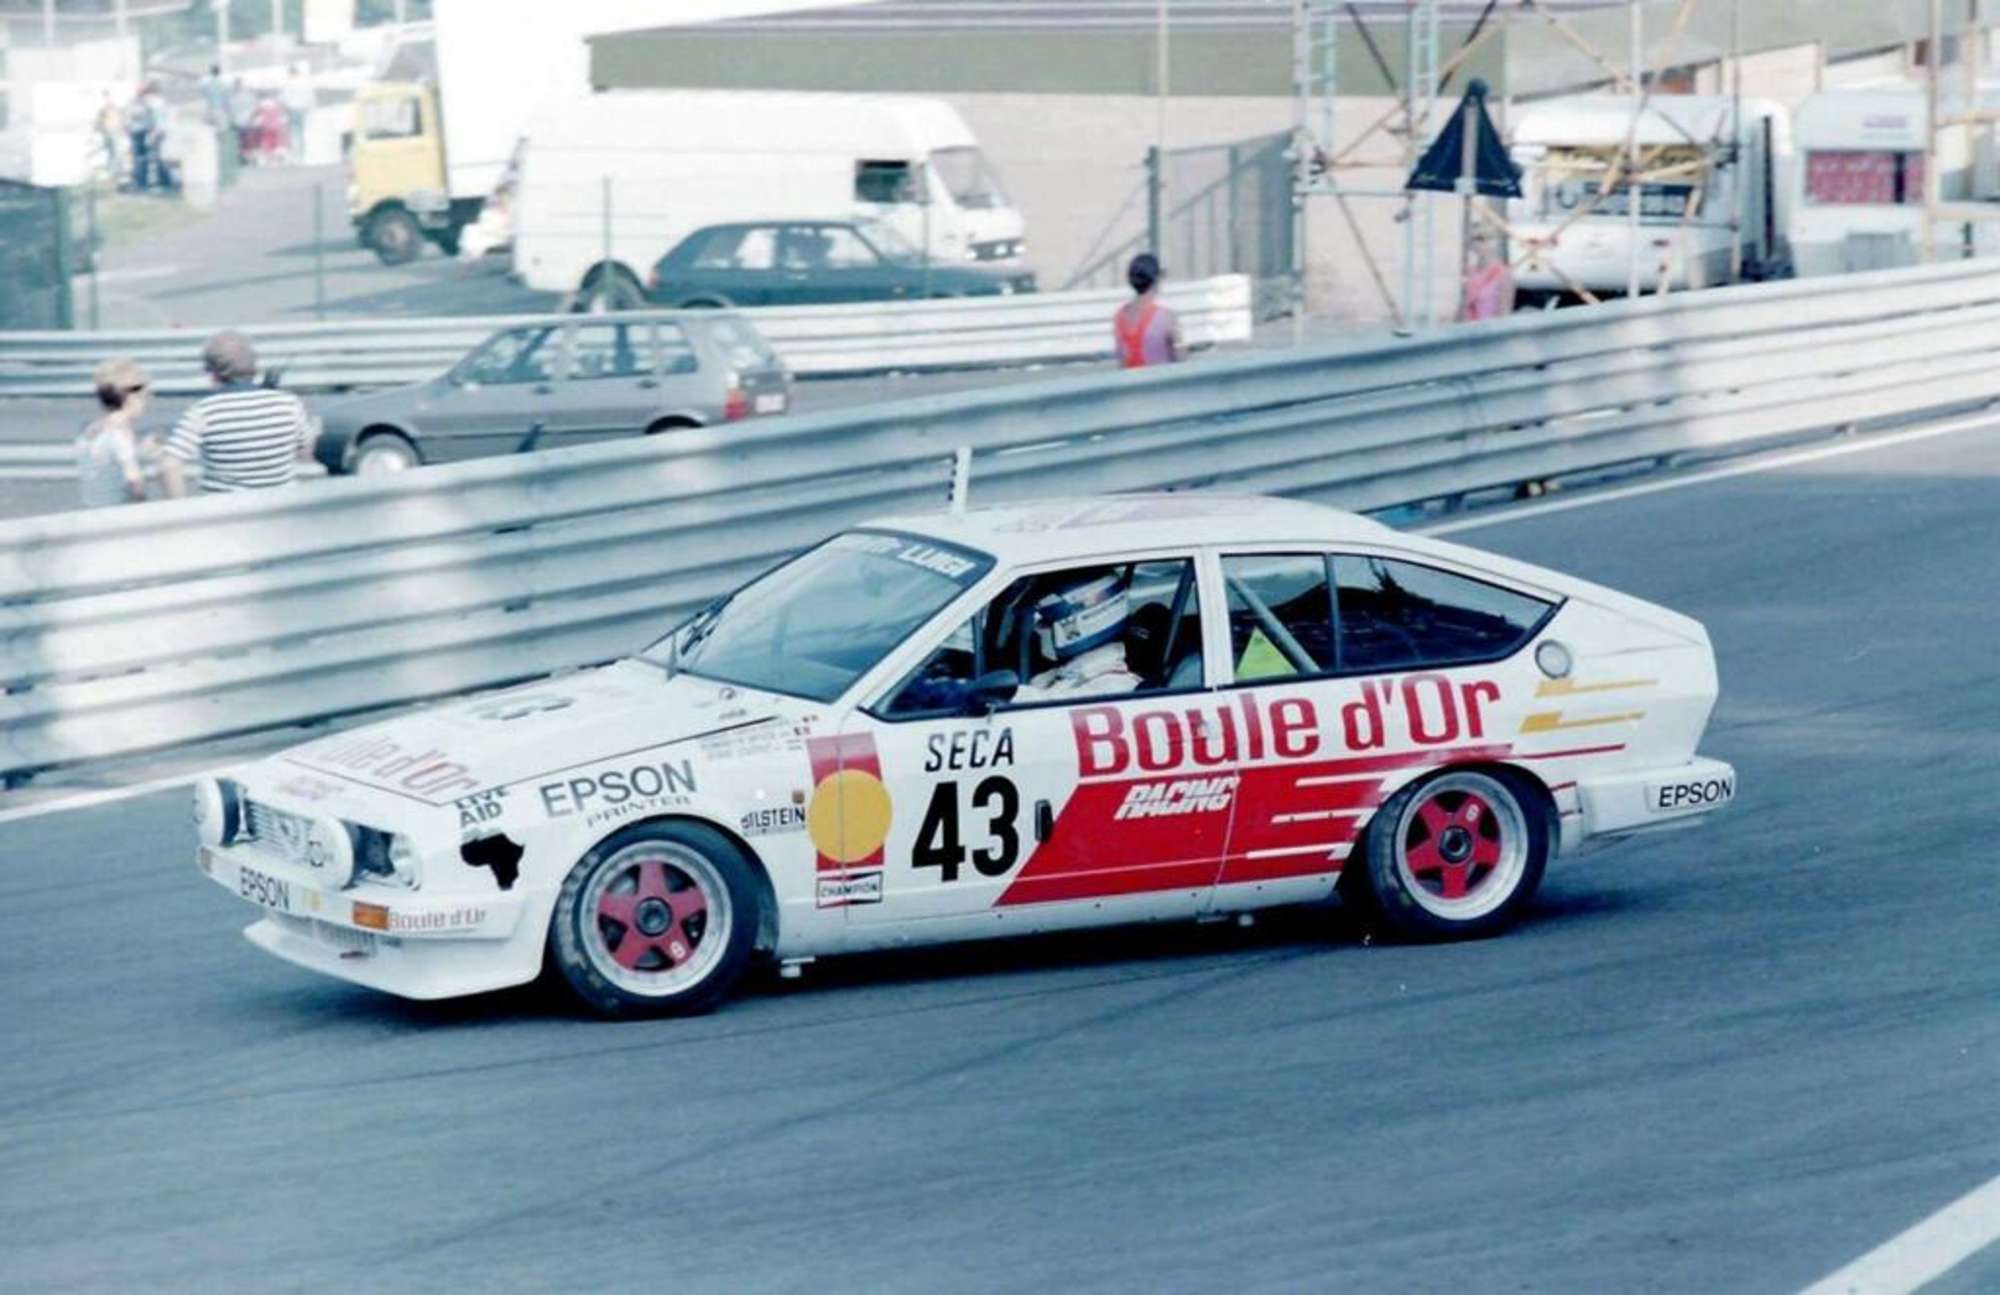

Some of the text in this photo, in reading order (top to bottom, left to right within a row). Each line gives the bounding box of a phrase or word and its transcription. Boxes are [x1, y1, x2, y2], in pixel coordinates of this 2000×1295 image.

[1068, 672, 1501, 778] Boule d'Or
[924, 726, 1016, 773] SECA
[539, 758, 698, 819] EPSON
[1113, 776, 1241, 821] RACING
[1657, 778, 1734, 808] EPSON
[459, 801, 504, 830] AID
[911, 774, 1021, 883] 43
[240, 864, 290, 911] EPSON
